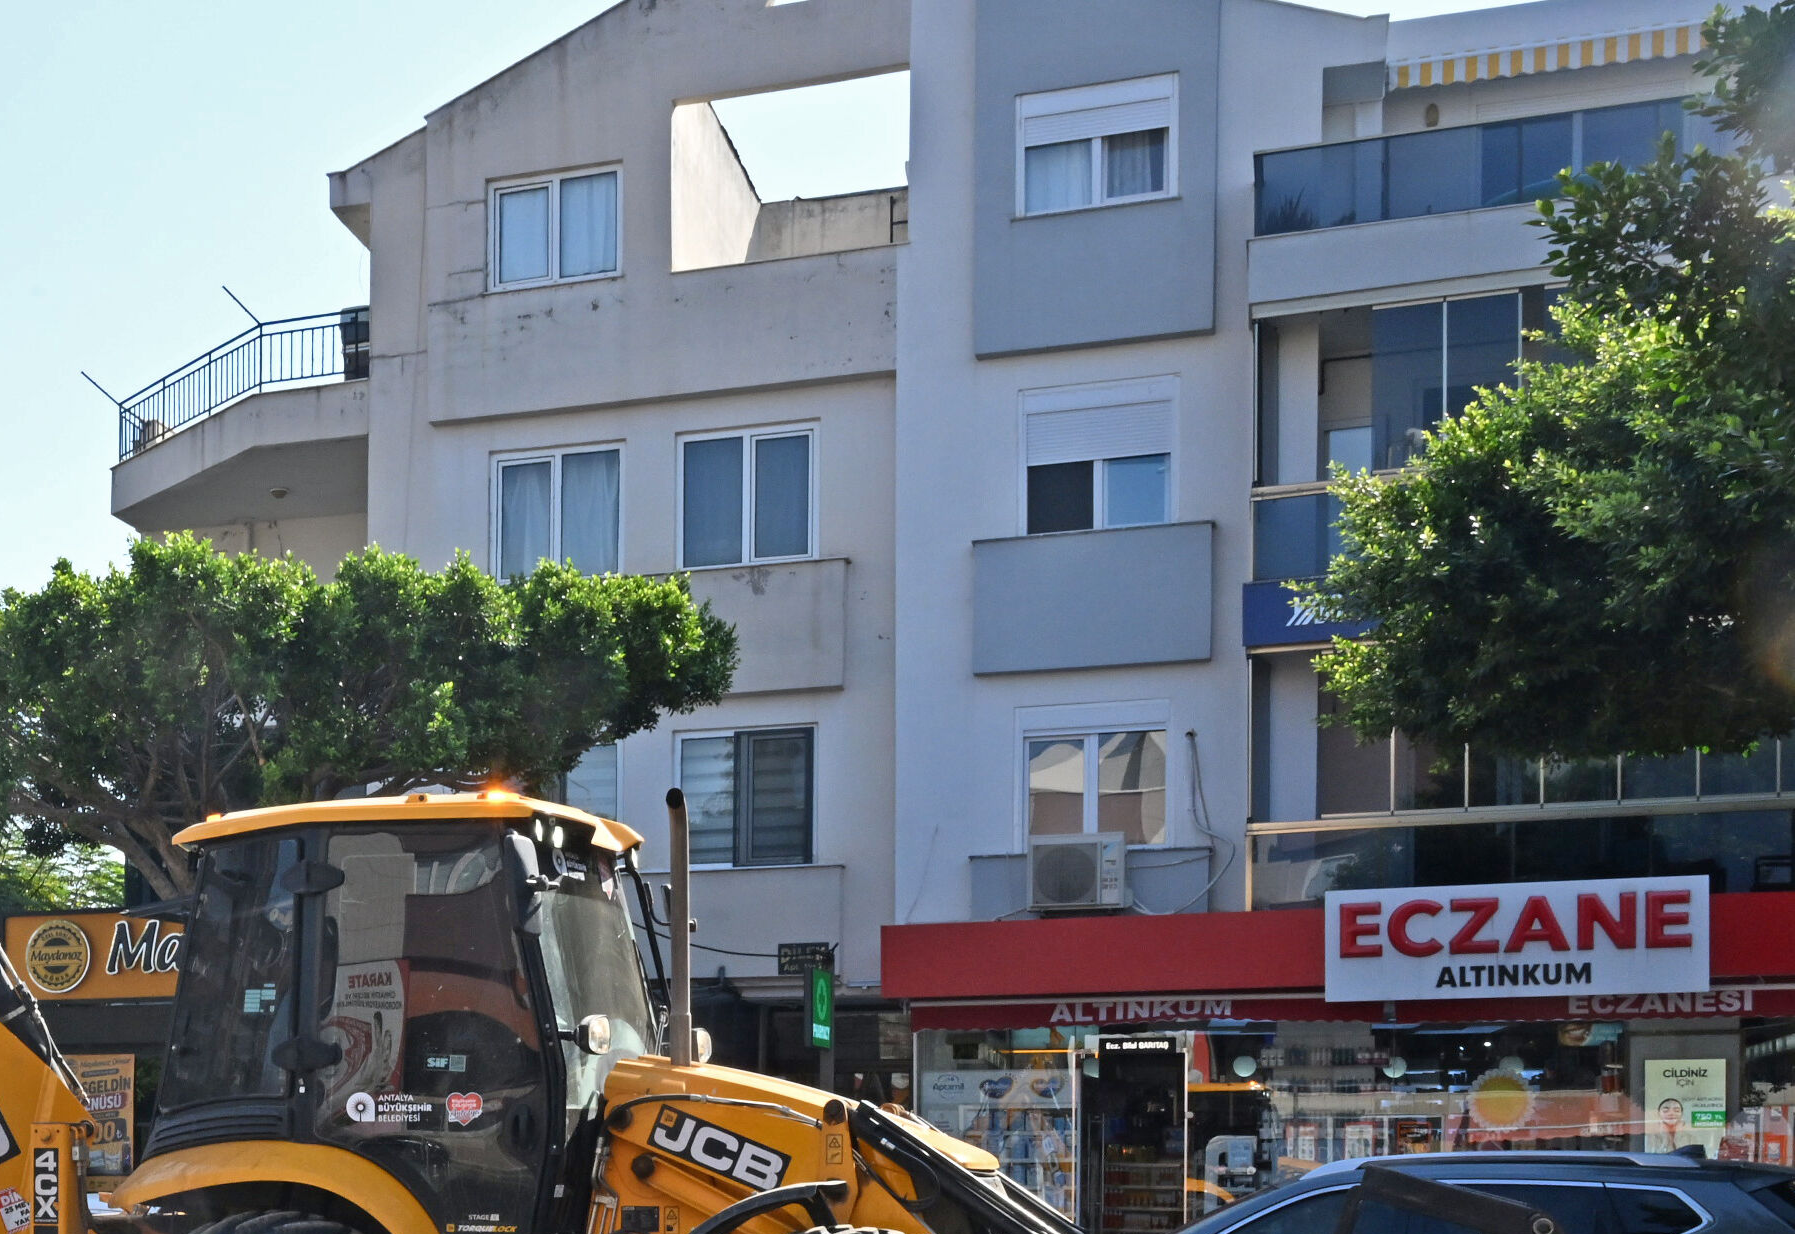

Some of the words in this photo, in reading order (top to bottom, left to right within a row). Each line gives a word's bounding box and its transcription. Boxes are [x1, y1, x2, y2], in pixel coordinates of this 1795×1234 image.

[1339, 890, 1693, 959] ECZANE
[31, 949, 83, 964] Maydonoz
[1435, 962, 1593, 988] ALTINKUM
[1050, 999, 1232, 1023] ALTINKUM
[1662, 1067, 1708, 1078] CİLDİNİZ
[378, 1094, 414, 1102] ANTALYA
[378, 1102, 432, 1113] BÜYÜKŞEHİR
[378, 1113, 421, 1122] BELEDİYESİ
[654, 1117, 783, 1190] JCB
[35, 1150, 58, 1218] 4CX
